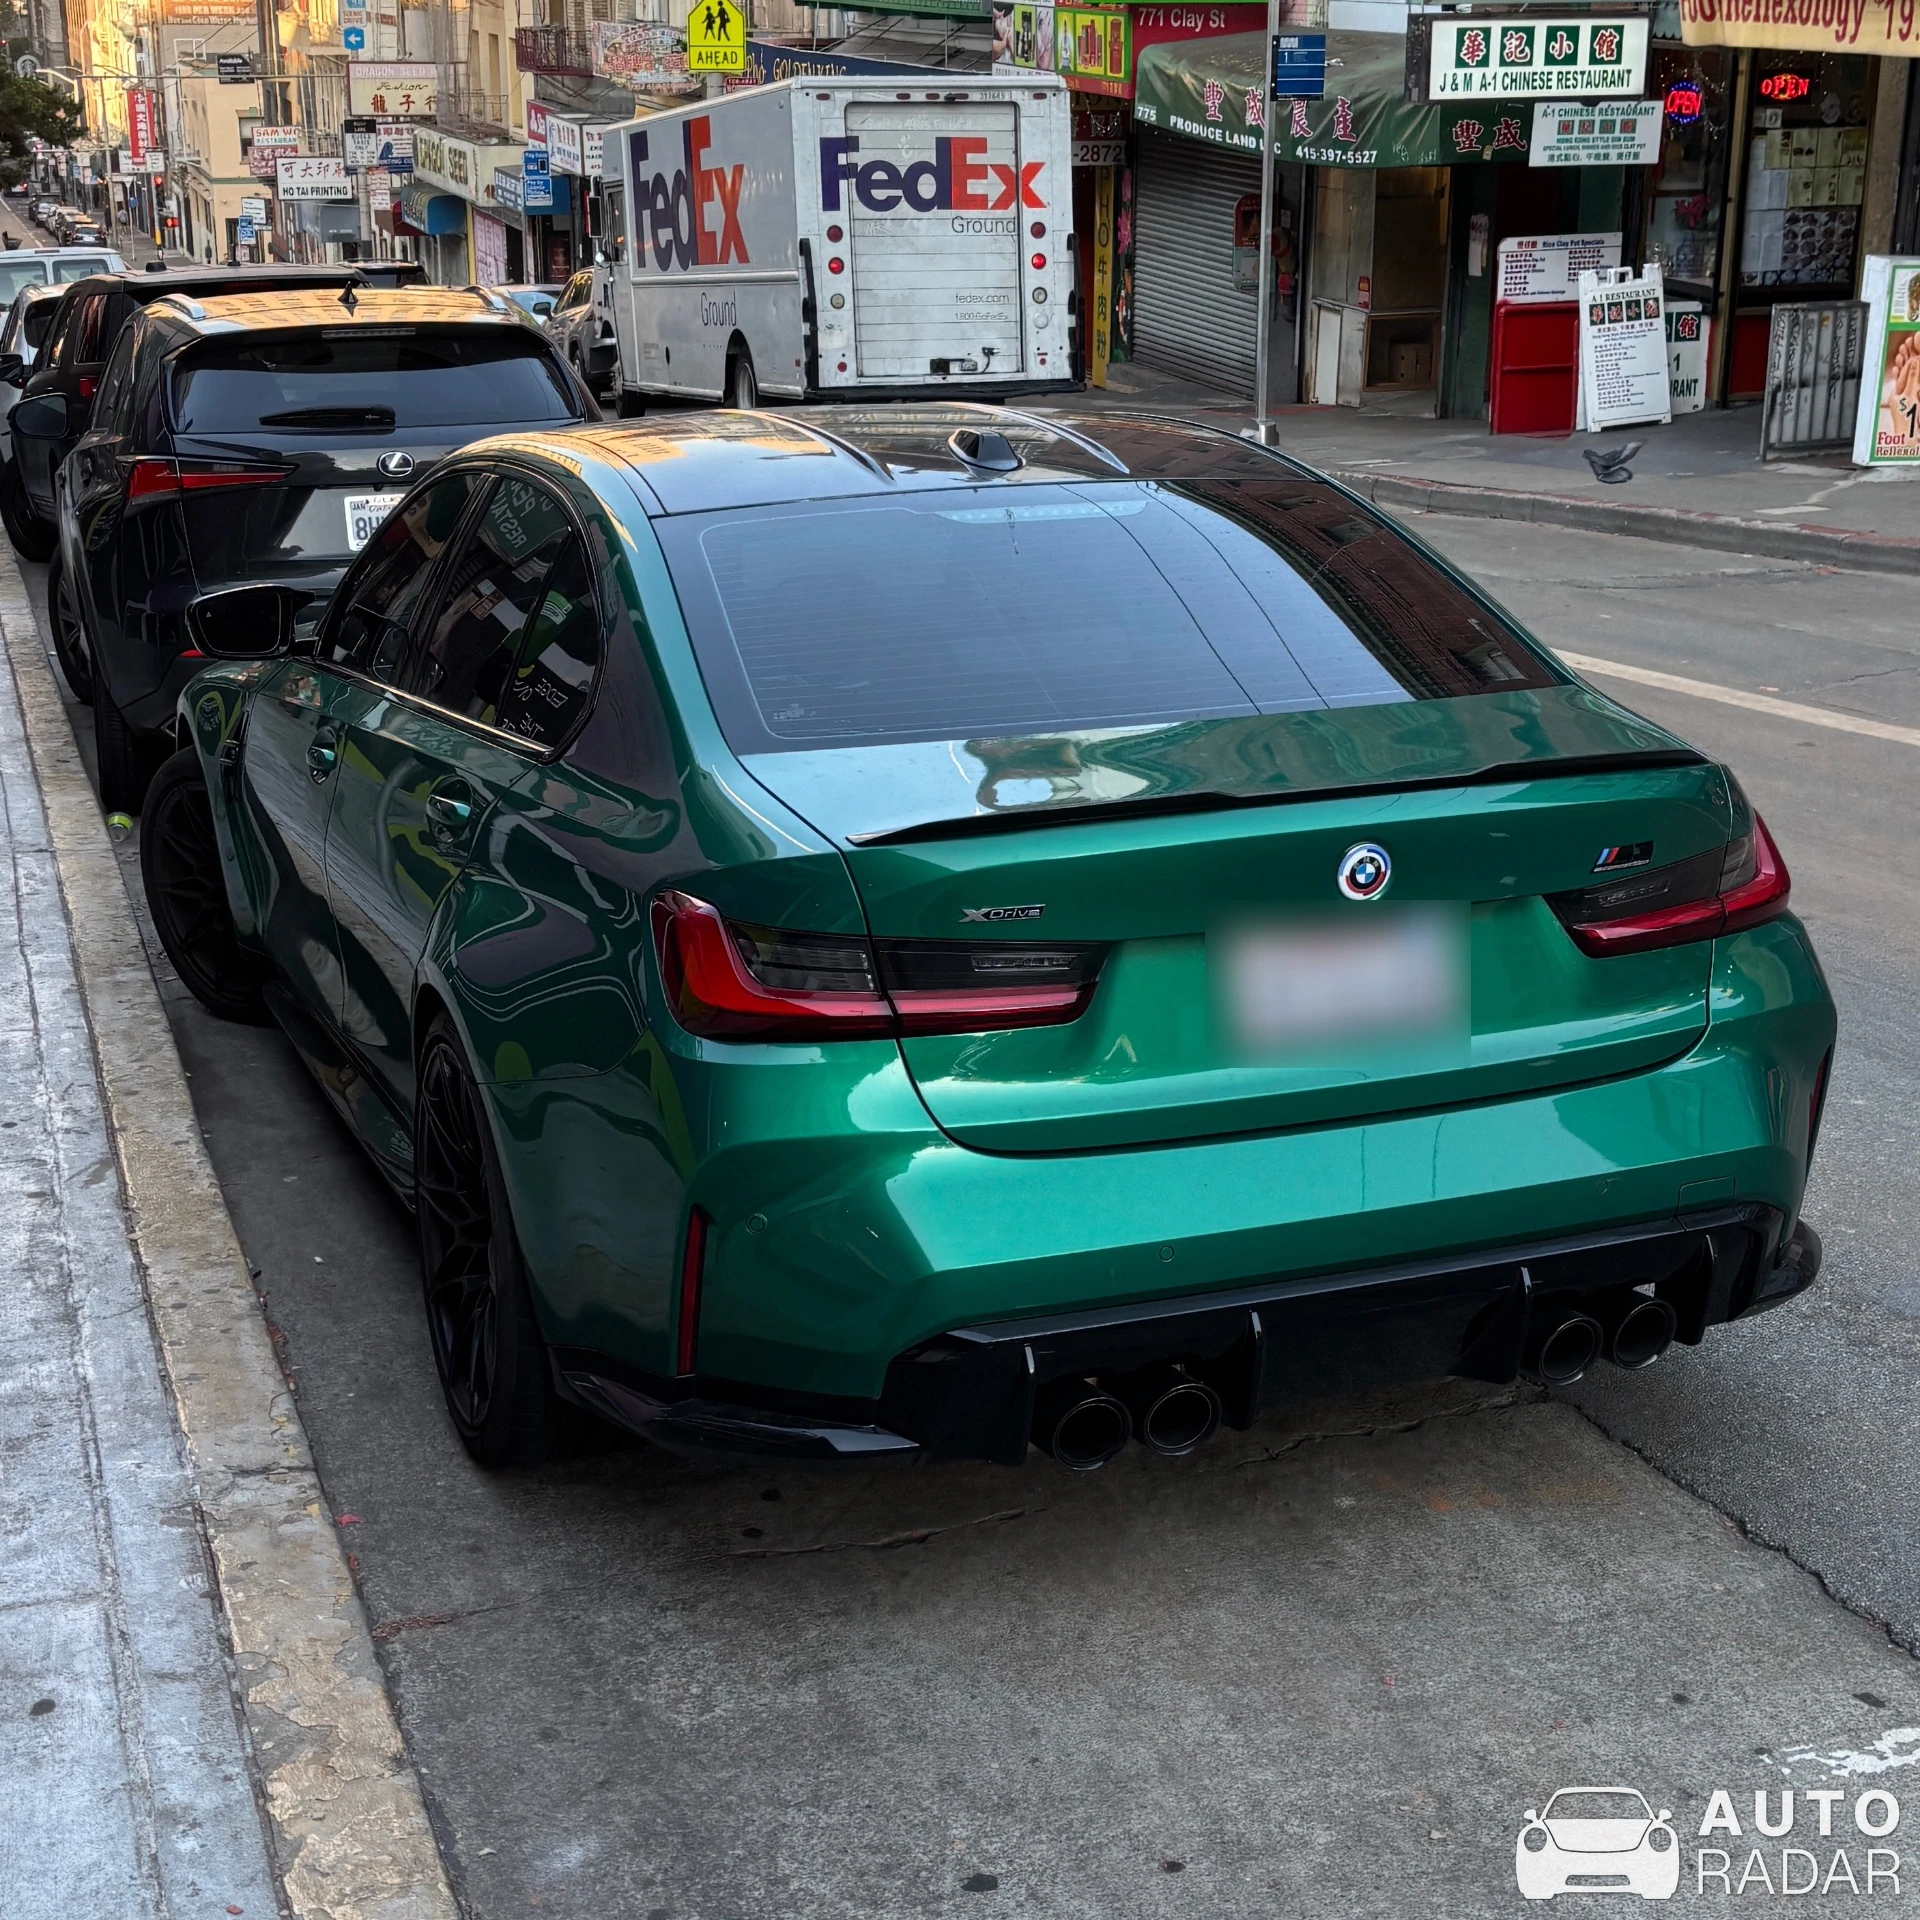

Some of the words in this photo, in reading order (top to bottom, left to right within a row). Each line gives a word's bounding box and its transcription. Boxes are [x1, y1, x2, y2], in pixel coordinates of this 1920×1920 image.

[1139, 8, 1164, 26] 771
[1171, 8, 1204, 32] Clay
[1209, 9, 1225, 28] St
[1458, 27, 1620, 67] 華記小館
[696, 50, 738, 66] AHEAD
[1284, 51, 1288, 64] 1
[355, 66, 394, 76] DRAGON
[399, 66, 425, 76] SEED
[1439, 73, 1447, 92] J
[1450, 73, 1458, 92] &
[1463, 72, 1472, 92] M
[1501, 71, 1553, 91] CHINESE
[1556, 69, 1632, 90] RESTAURANT
[1760, 77, 1809, 97] OPEN
[1666, 89, 1702, 114] OPEN
[1137, 106, 1157, 121] 775
[1557, 106, 1596, 118] CHINESE
[1598, 105, 1656, 118] RESTAURANT
[256, 128, 279, 137] SAM
[1169, 114, 1223, 142] PRODUCE
[1225, 130, 1257, 149] LAND
[1259, 136, 1282, 155] LC
[819, 136, 1047, 212] FedEx
[283, 187, 294, 196] HO
[296, 187, 309, 196] TAI
[310, 186, 348, 196] PRINTING
[629, 115, 750, 272] FedEx
[951, 216, 1016, 234] Ground
[955, 293, 1009, 304] fedex.com
[1605, 289, 1656, 301] RESTAURANT
[701, 291, 737, 327] Ground
[1877, 432, 1905, 446] Foot
[355, 516, 385, 541] 8H
